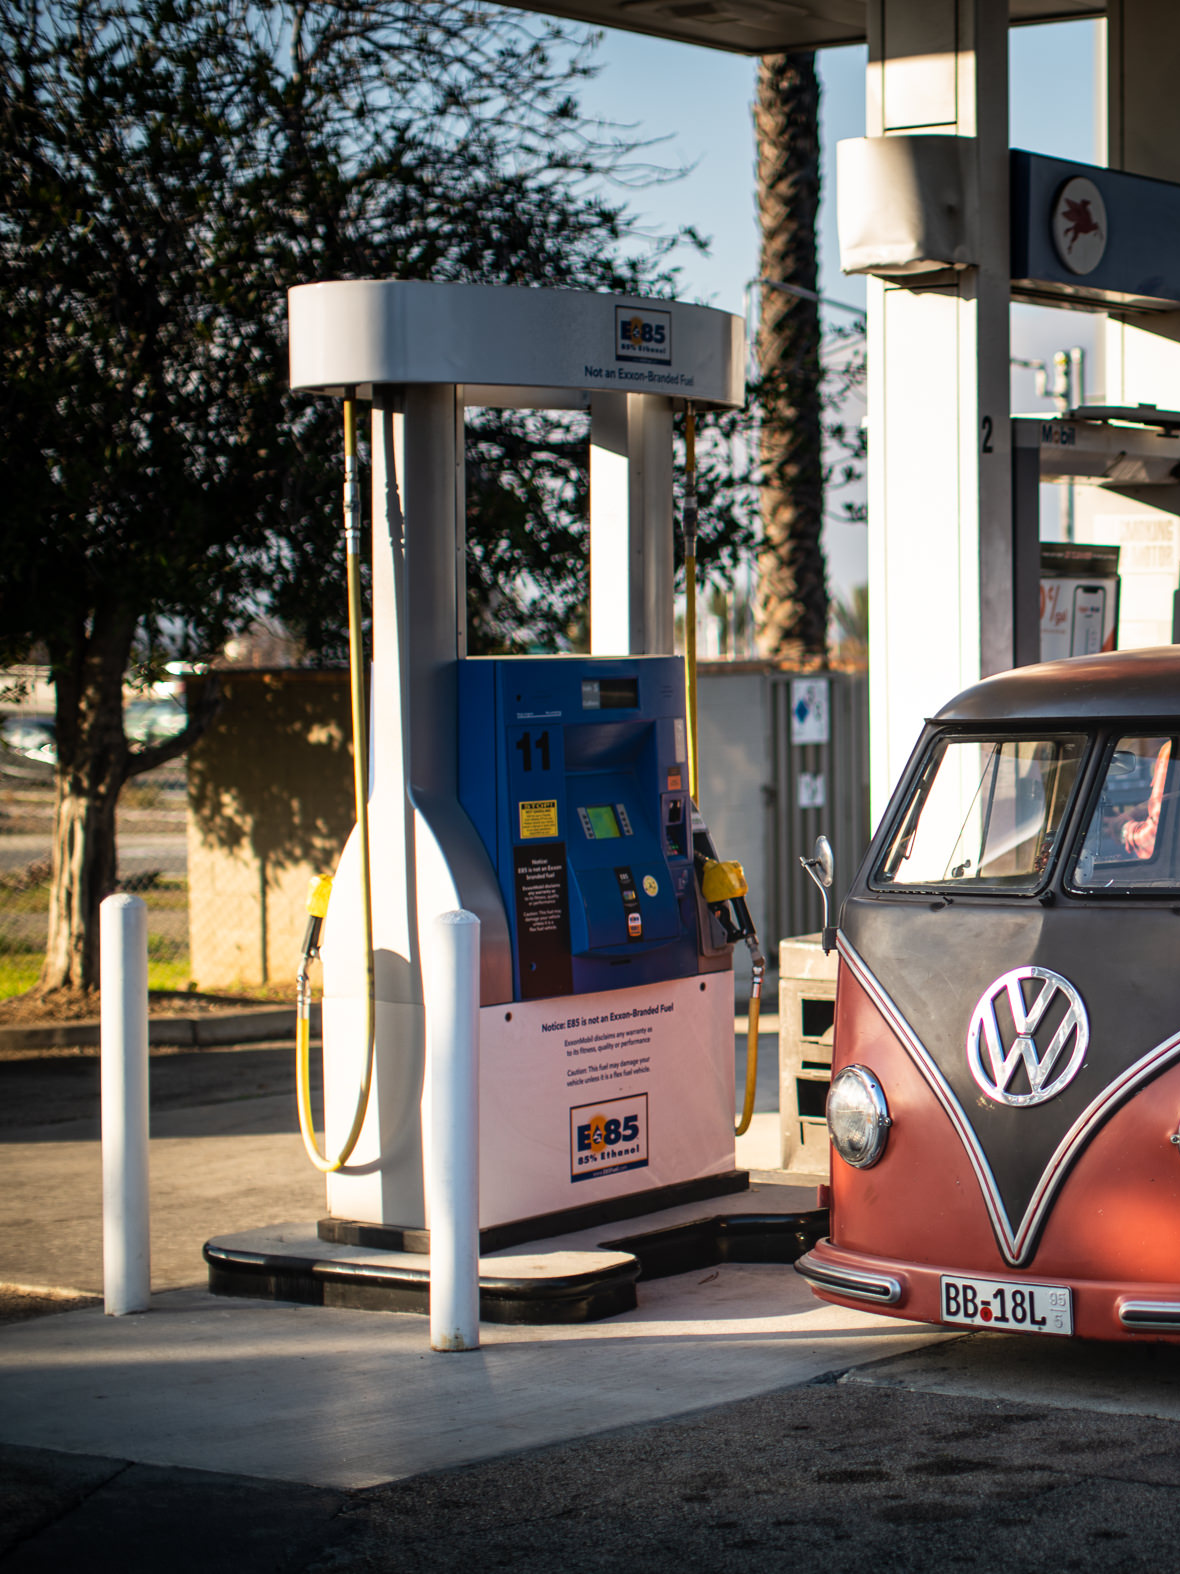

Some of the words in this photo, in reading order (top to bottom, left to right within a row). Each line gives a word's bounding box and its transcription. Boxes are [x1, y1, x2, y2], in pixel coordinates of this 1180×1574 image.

[584, 365, 603, 378] Not
[605, 369, 616, 379] an
[618, 368, 679, 385] Exxon-Branded
[680, 374, 694, 386] Fuel
[982, 416, 993, 453] 2
[1042, 424, 1076, 446] Mobil
[516, 731, 551, 772] 11
[541, 1021, 566, 1032] Notice:
[566, 1018, 580, 1029] E85
[581, 1017, 587, 1026] is
[588, 1016, 600, 1025] not
[600, 1015, 609, 1023] an
[609, 1005, 659, 1021] Exxon-Branded
[660, 1003, 674, 1013] Fuel
[564, 1035, 593, 1047] ExxonMobil
[594, 1032, 615, 1043] disclaims
[625, 1028, 647, 1037] warranty
[967, 966, 1089, 1107] VW
[588, 1065, 598, 1073] This
[598, 1063, 608, 1071] fuel
[609, 1062, 619, 1070] may
[620, 1059, 639, 1067] damage
[566, 1078, 584, 1087] vehicle
[584, 1075, 600, 1084] unless
[623, 1069, 633, 1077] fuel
[577, 1114, 639, 1152] E85
[578, 1154, 597, 1165] 85%
[601, 1143, 640, 1160] Ethanol
